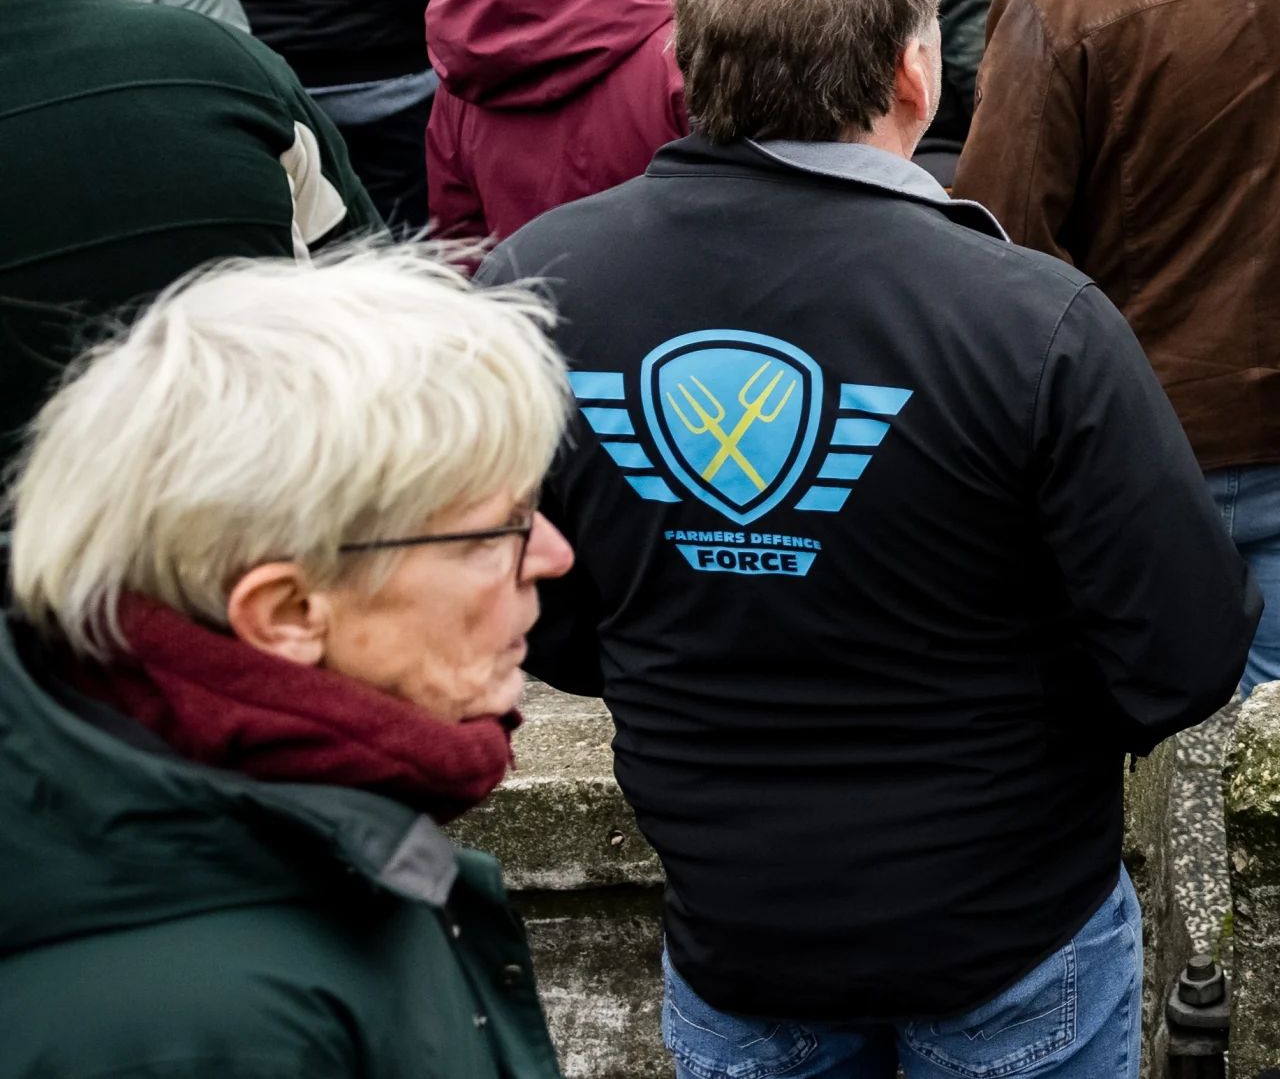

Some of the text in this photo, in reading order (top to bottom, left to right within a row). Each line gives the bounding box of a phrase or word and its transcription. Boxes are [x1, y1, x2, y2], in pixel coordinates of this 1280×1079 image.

[665, 531, 821, 549] FARMERS DEFENCE
[696, 549, 799, 572] FORCE
